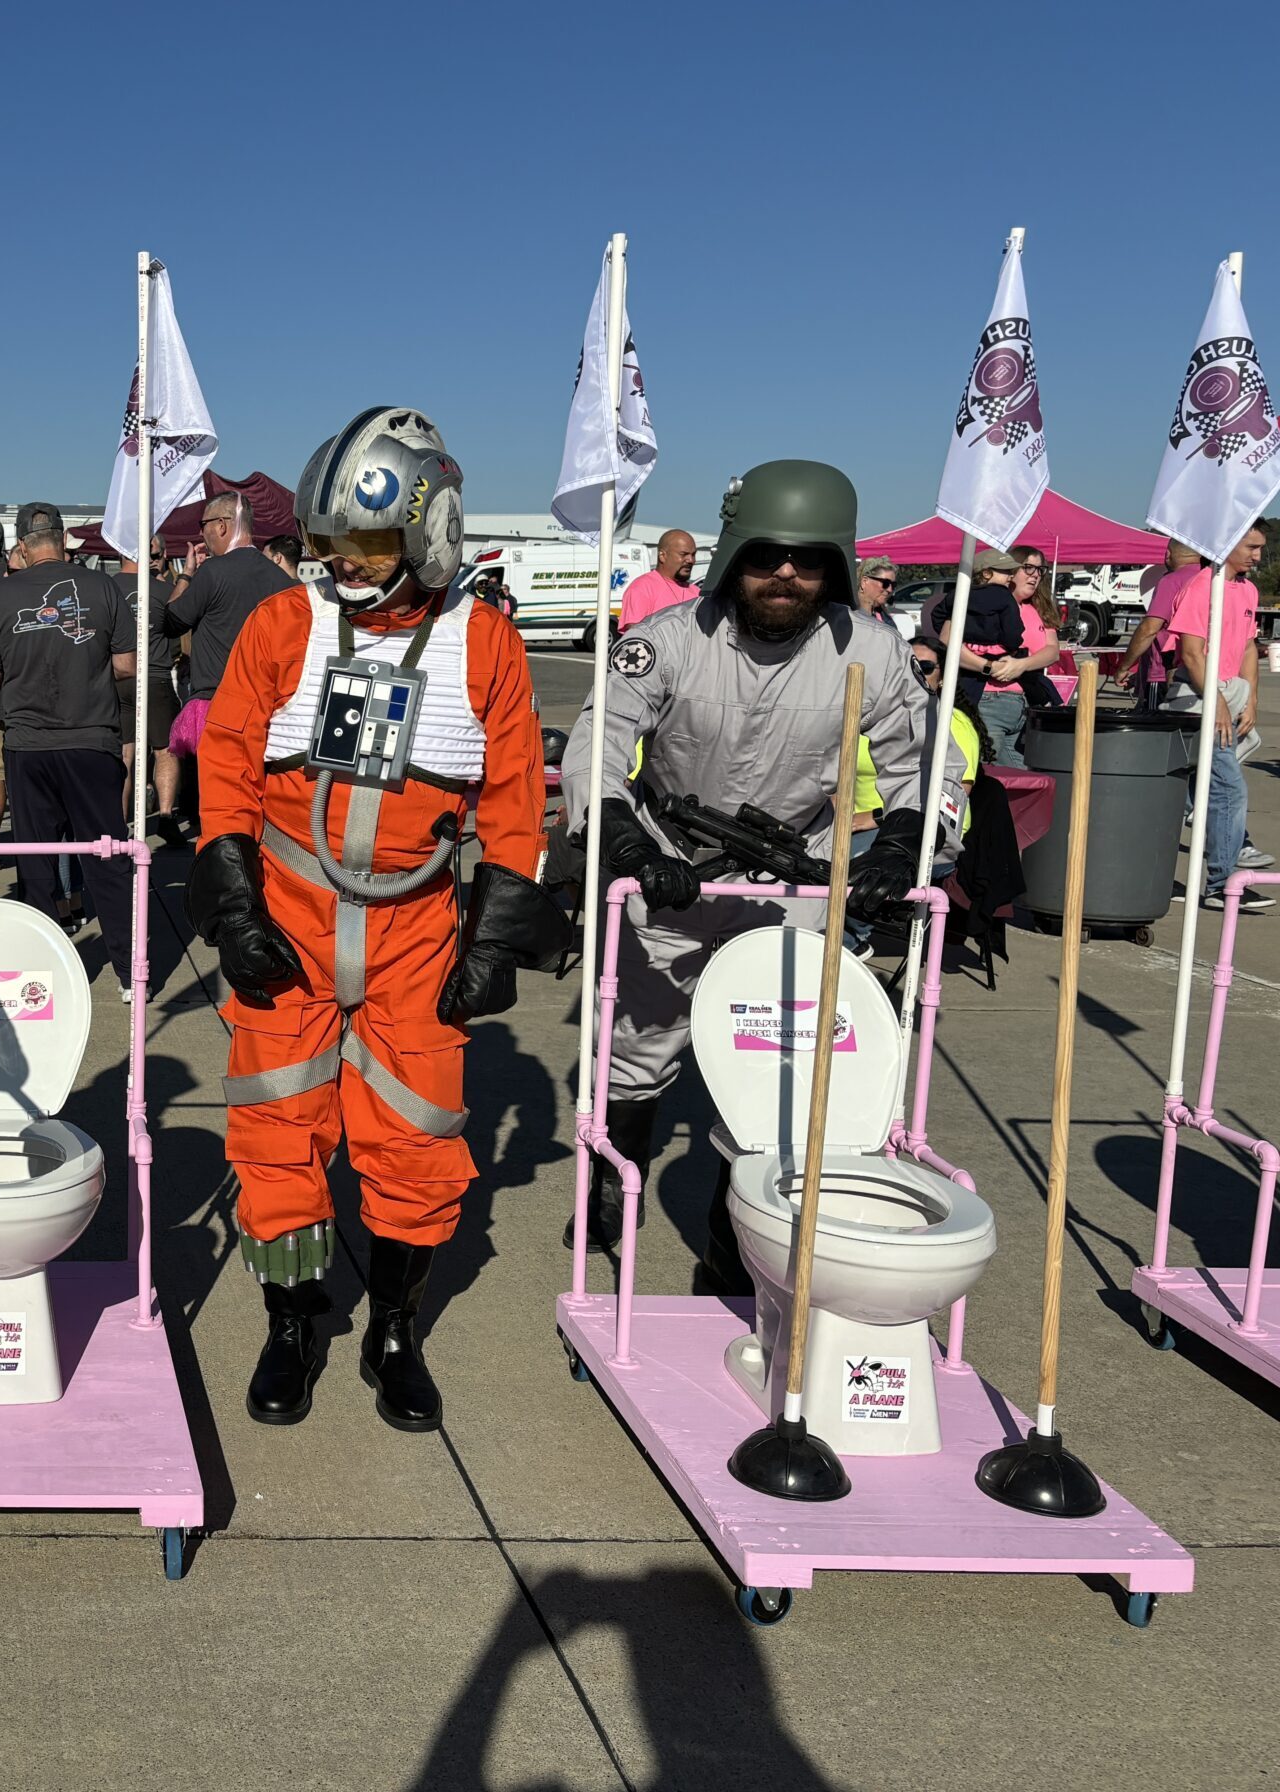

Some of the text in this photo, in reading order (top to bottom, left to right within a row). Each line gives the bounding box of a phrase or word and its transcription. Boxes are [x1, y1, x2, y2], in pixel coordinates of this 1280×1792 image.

[532, 571, 599, 580] NEW WINDSOR
[743, 1019, 783, 1028] HELPED
[737, 1029, 817, 1038] FLUSH CANCER
[878, 1368, 907, 1379] PULL
[849, 1393, 905, 1406] A PLANE
